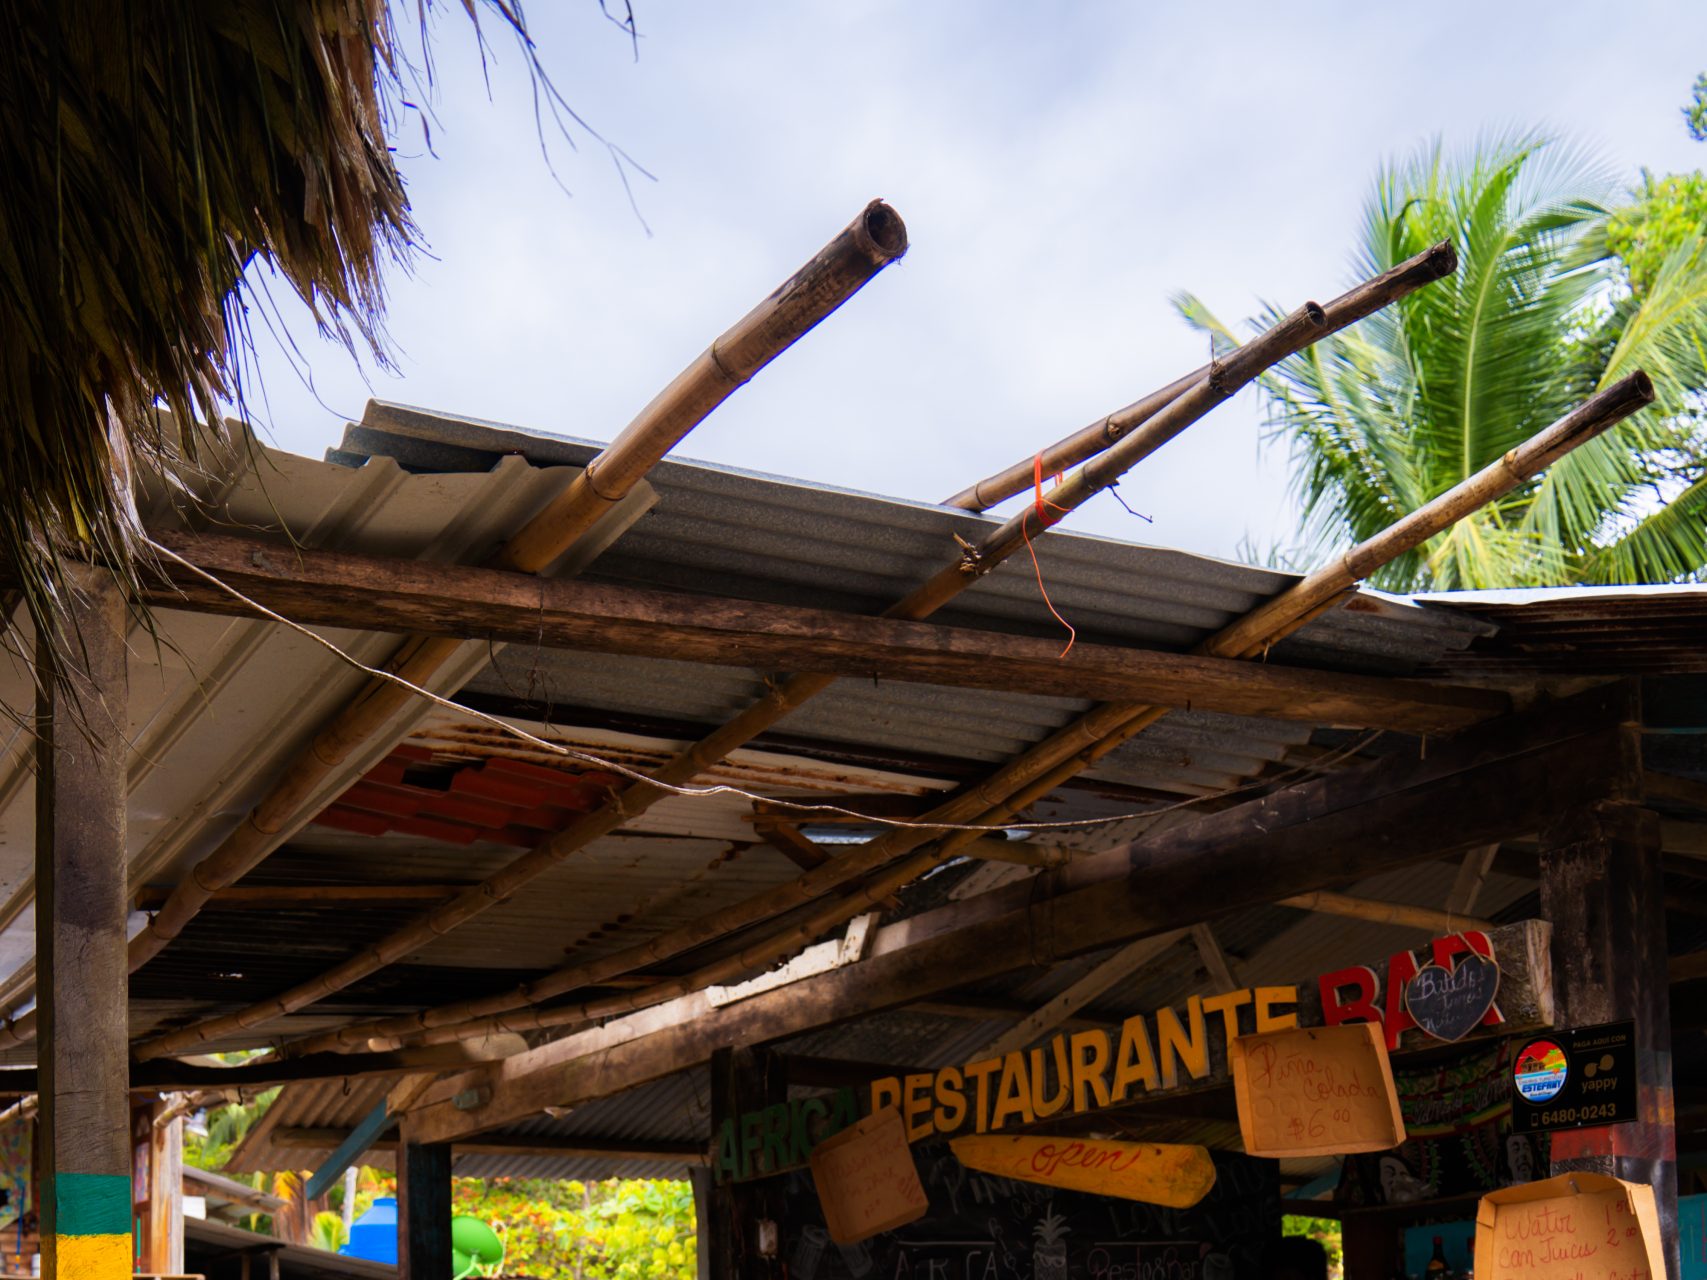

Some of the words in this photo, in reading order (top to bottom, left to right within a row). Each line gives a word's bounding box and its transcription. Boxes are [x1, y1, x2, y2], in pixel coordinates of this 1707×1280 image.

[1610, 1034, 1626, 1044] CON
[1581, 1077, 1618, 1094] yappy
[1541, 1103, 1617, 1126] 6480-0243
[1504, 1206, 1577, 1240] Water
